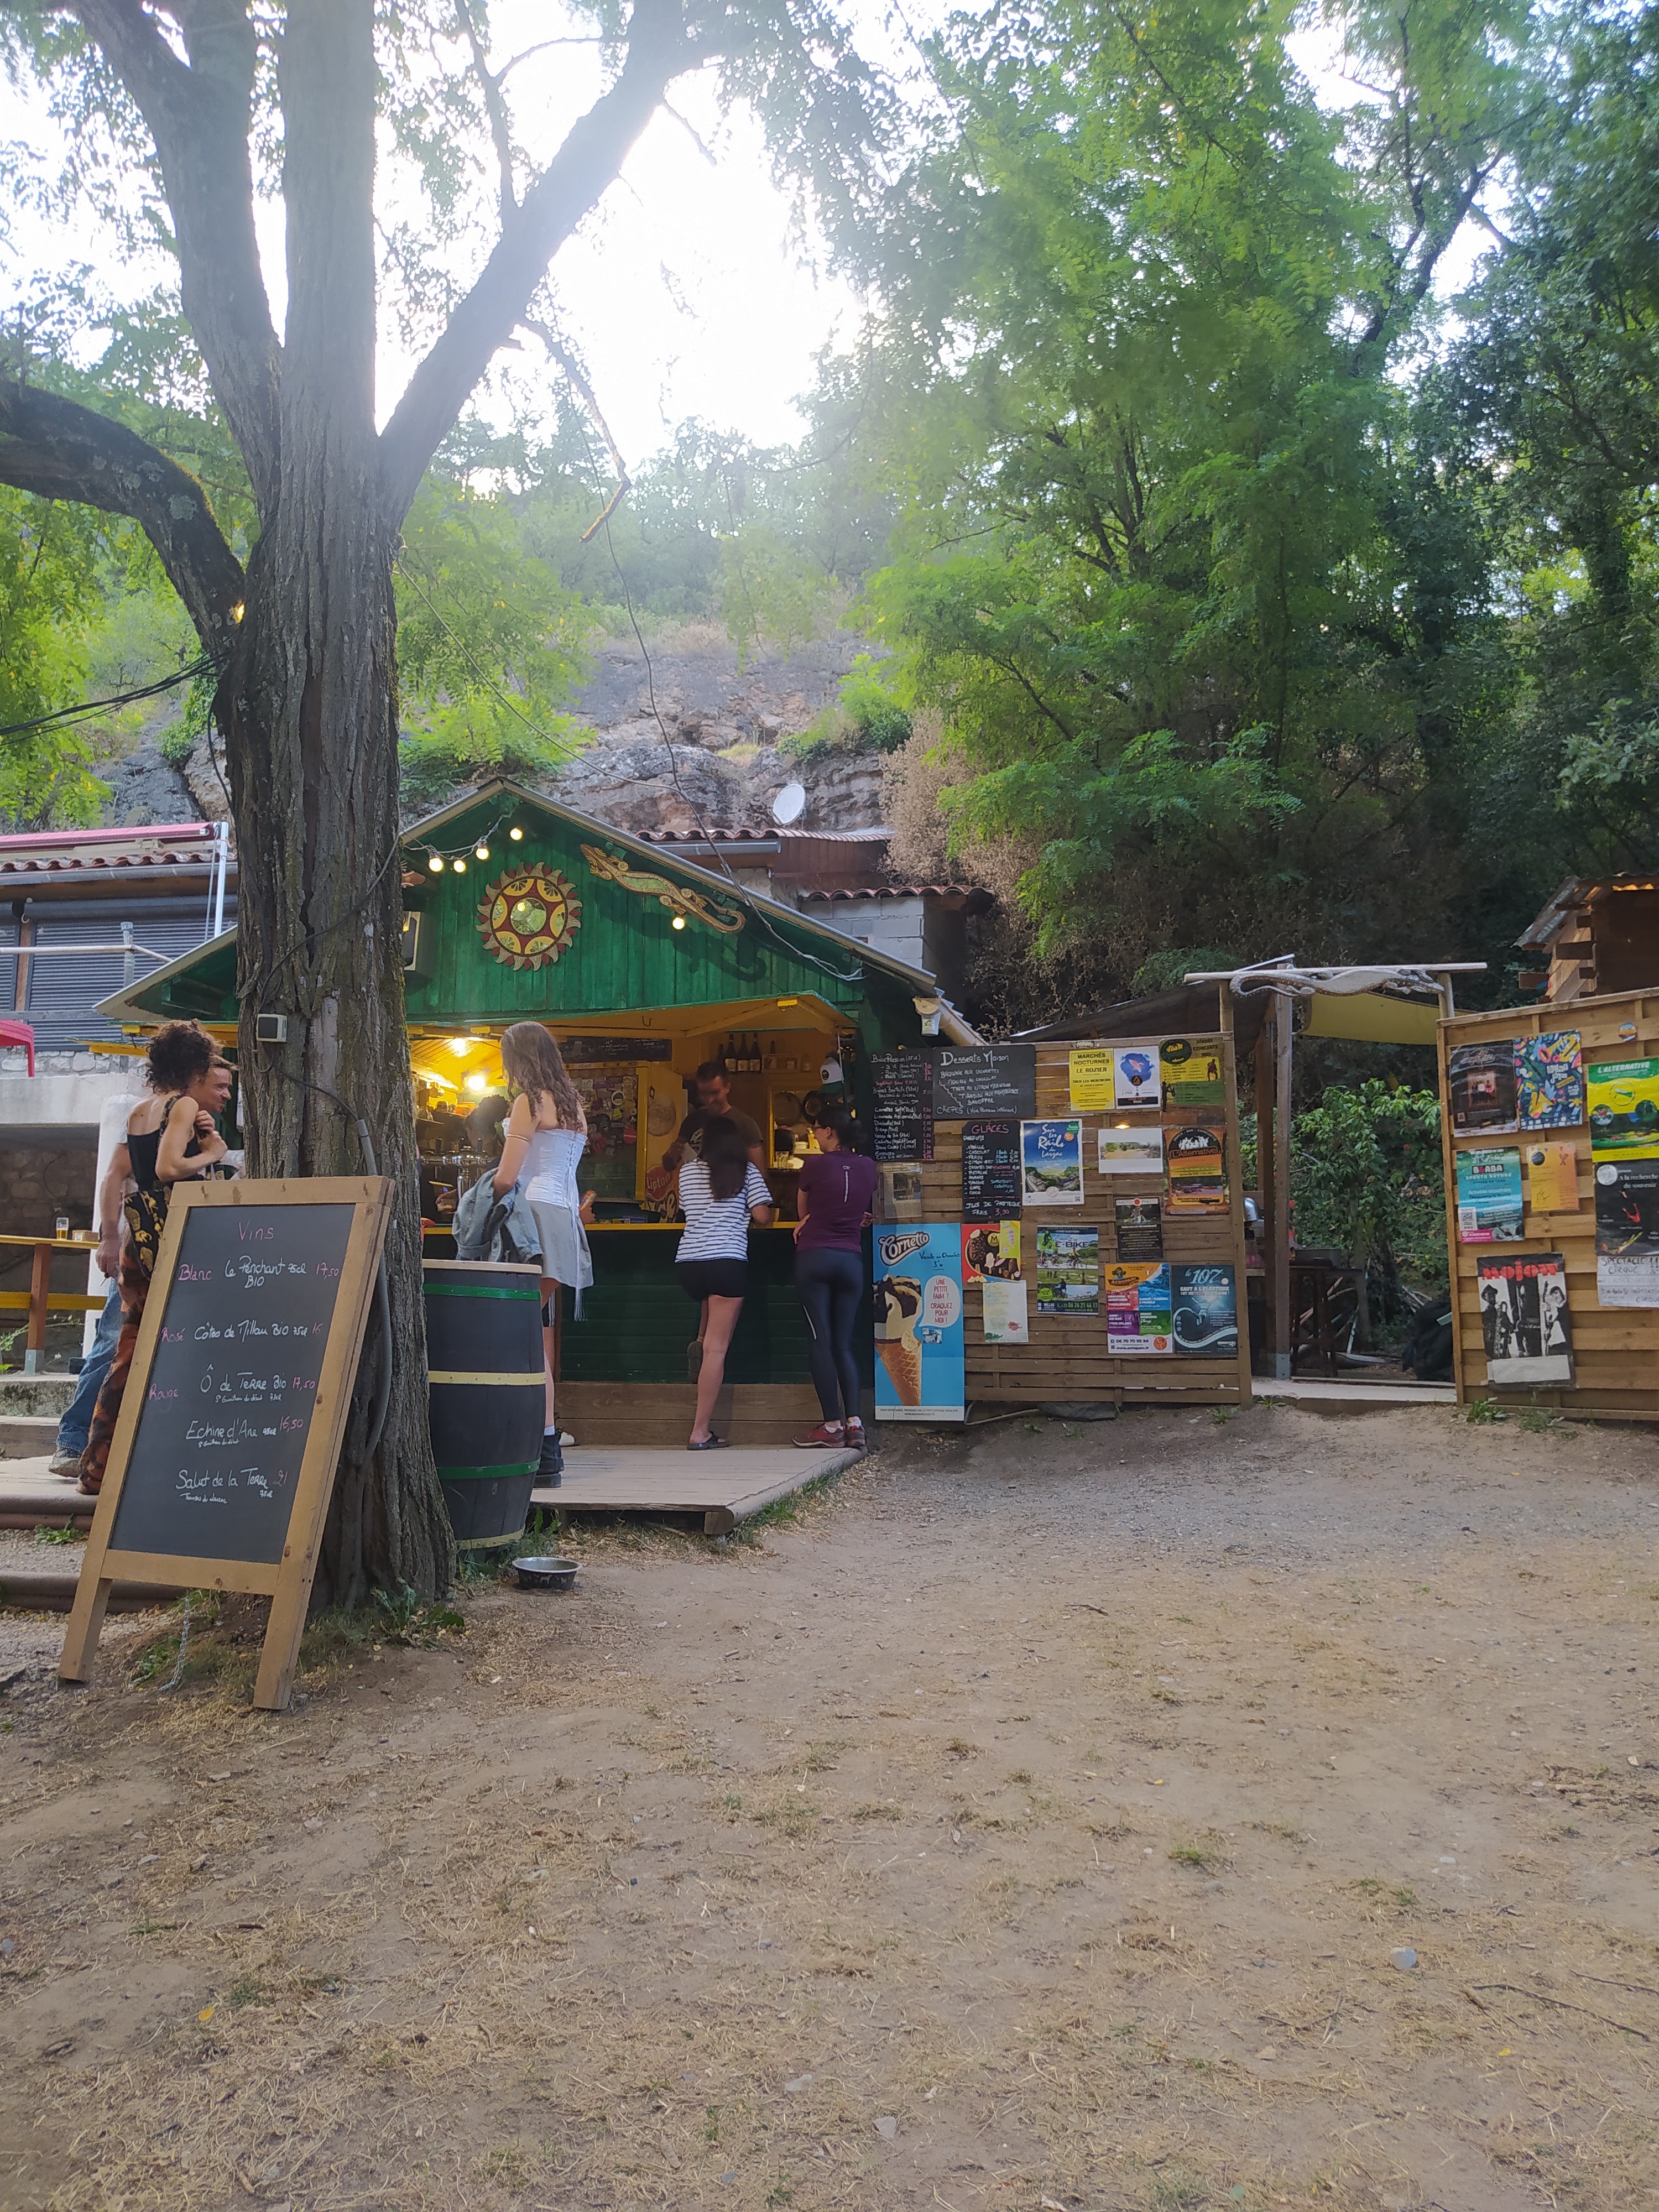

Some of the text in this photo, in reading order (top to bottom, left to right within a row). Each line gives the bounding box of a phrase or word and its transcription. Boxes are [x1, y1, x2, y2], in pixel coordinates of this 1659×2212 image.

[940, 1050, 1009, 1068] Desserts Maison
[1598, 1061, 1650, 1074] L'ALTERNATIVE
[1042, 1124, 1056, 1134] Sur
[1038, 1134, 1065, 1150] Rails
[1042, 1151, 1063, 1159] Larzac
[1172, 1149, 1217, 1159] L'Alternative
[646, 1172, 671, 1192] Lipton
[238, 1220, 274, 1241] Vins
[879, 1232, 929, 1264] Cornetto
[178, 1264, 212, 1281] Blanc
[316, 1261, 340, 1280] 17,50
[1190, 1269, 1224, 1284] 107
[244, 1275, 265, 1288] BIO
[161, 1327, 186, 1343] Rosé
[194, 1322, 221, 1340] Côtes
[224, 1324, 236, 1338] de
[148, 1383, 179, 1401] Rouge
[220, 1374, 232, 1391] de
[292, 1376, 316, 1391] 17,50
[279, 1416, 304, 1433] 16,50
[176, 1469, 210, 1489] Salut
[212, 1470, 223, 1486] de
[228, 1469, 238, 1486] la
